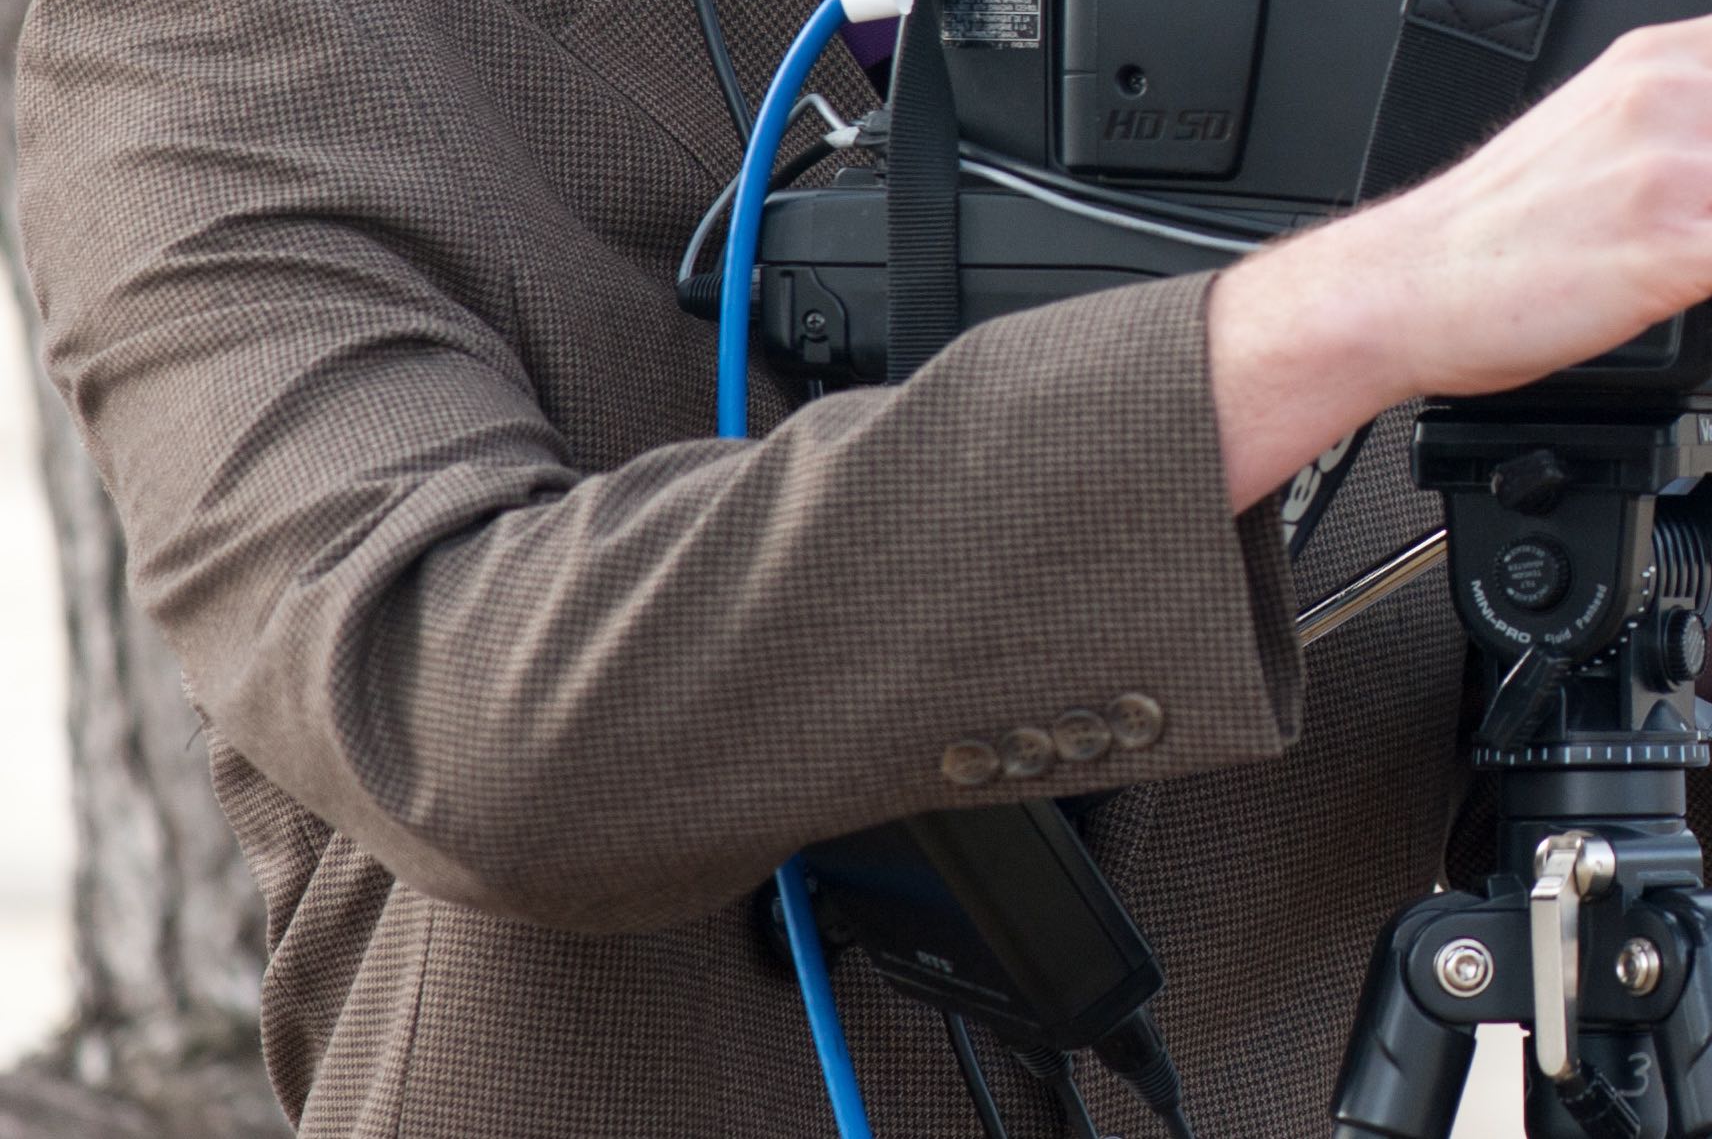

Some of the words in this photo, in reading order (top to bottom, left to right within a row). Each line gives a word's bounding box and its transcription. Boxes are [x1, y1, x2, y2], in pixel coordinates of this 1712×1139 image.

[1103, 109, 1165, 141] HD
[1176, 109, 1233, 141] SD
[1471, 579, 1532, 644] MINI-PRO
[1616, 1051, 1652, 1097] 3
